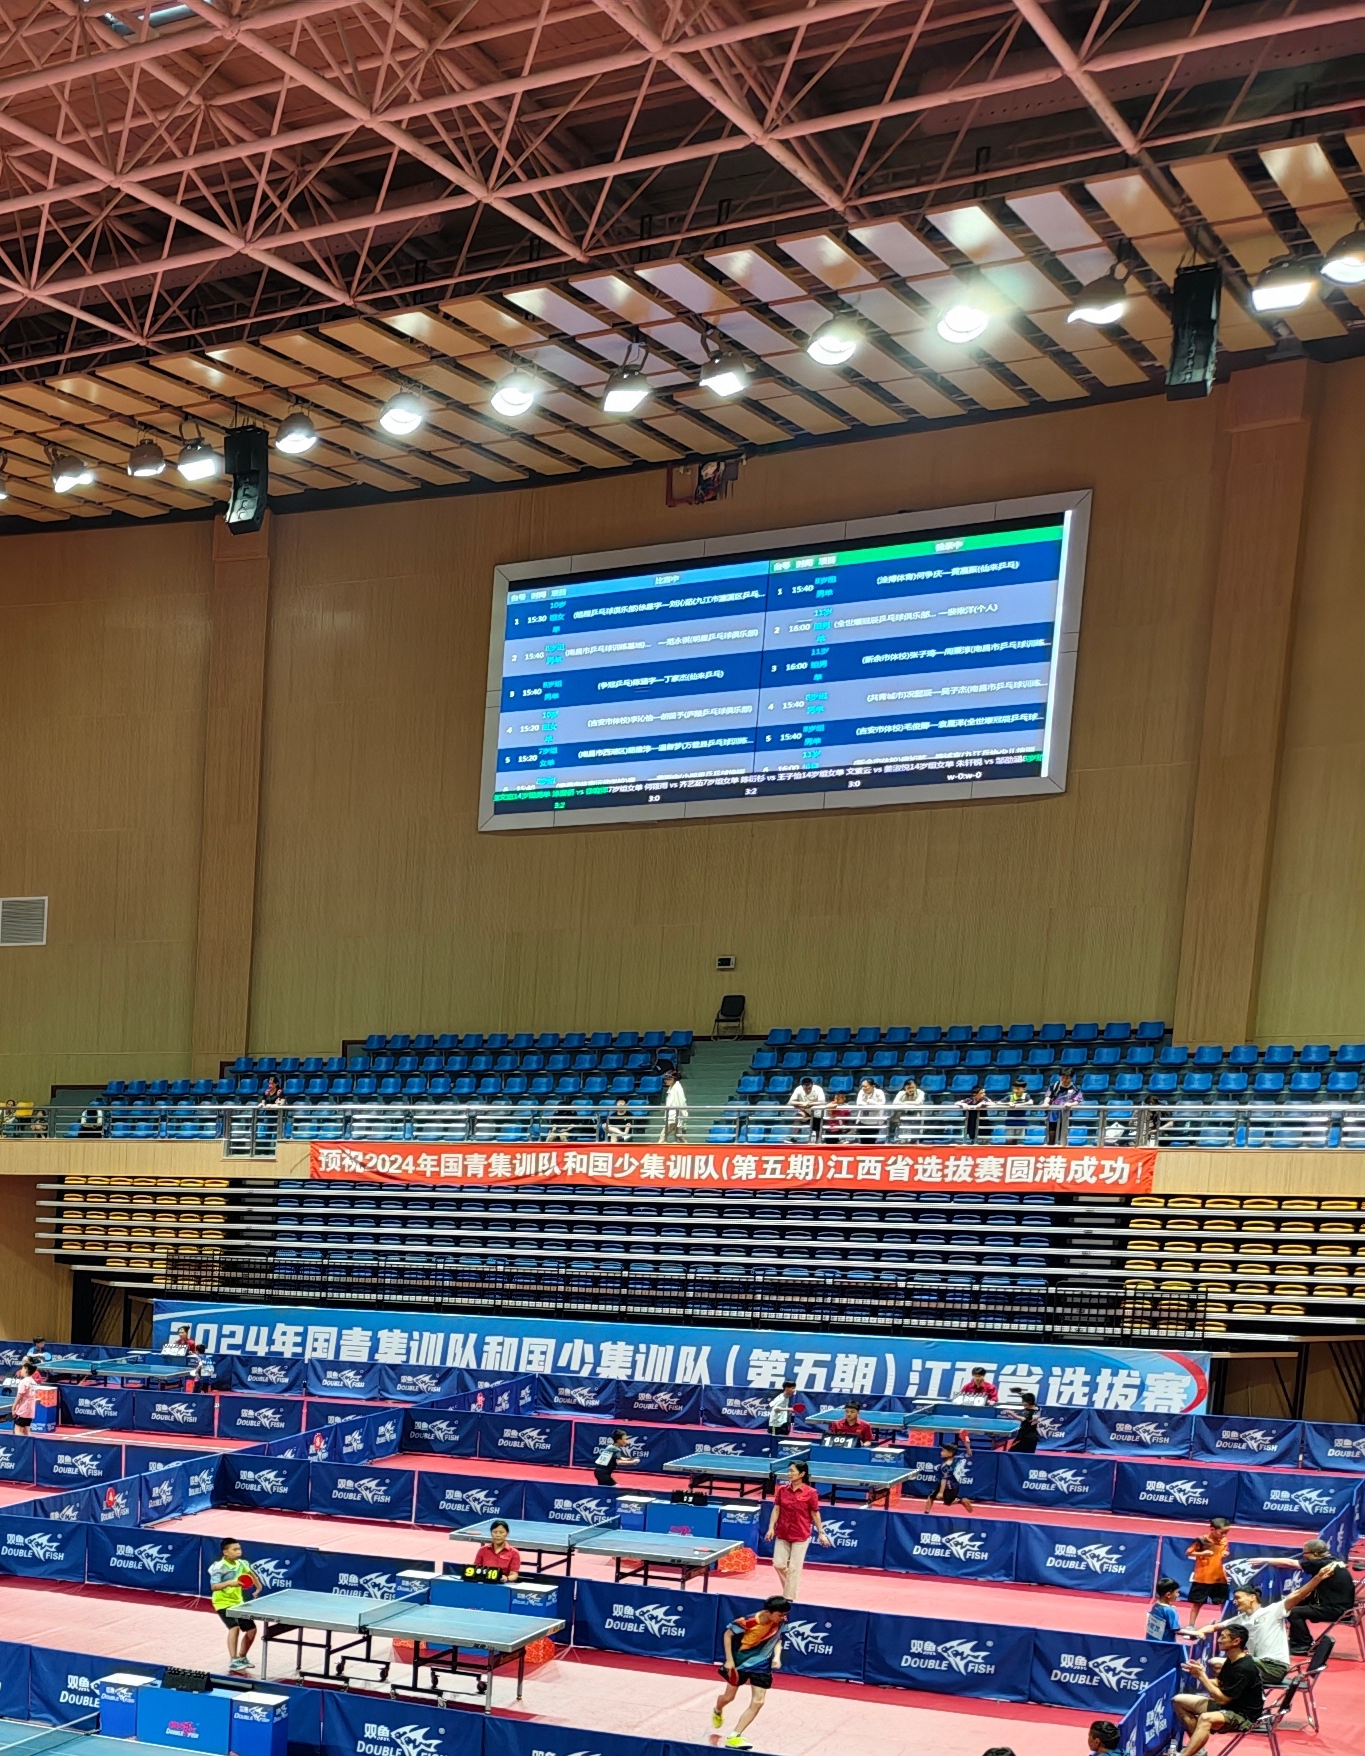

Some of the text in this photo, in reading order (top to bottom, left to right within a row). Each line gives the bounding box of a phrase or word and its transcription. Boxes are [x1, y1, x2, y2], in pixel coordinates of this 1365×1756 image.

[1263, 1498, 1336, 1514] DOUBLE FISH
[1, 1546, 64, 1561] DOUBLE FISH
[912, 1545, 989, 1560] DOUBLE FISH
[901, 1651, 995, 1674] DOUBLE FISH
